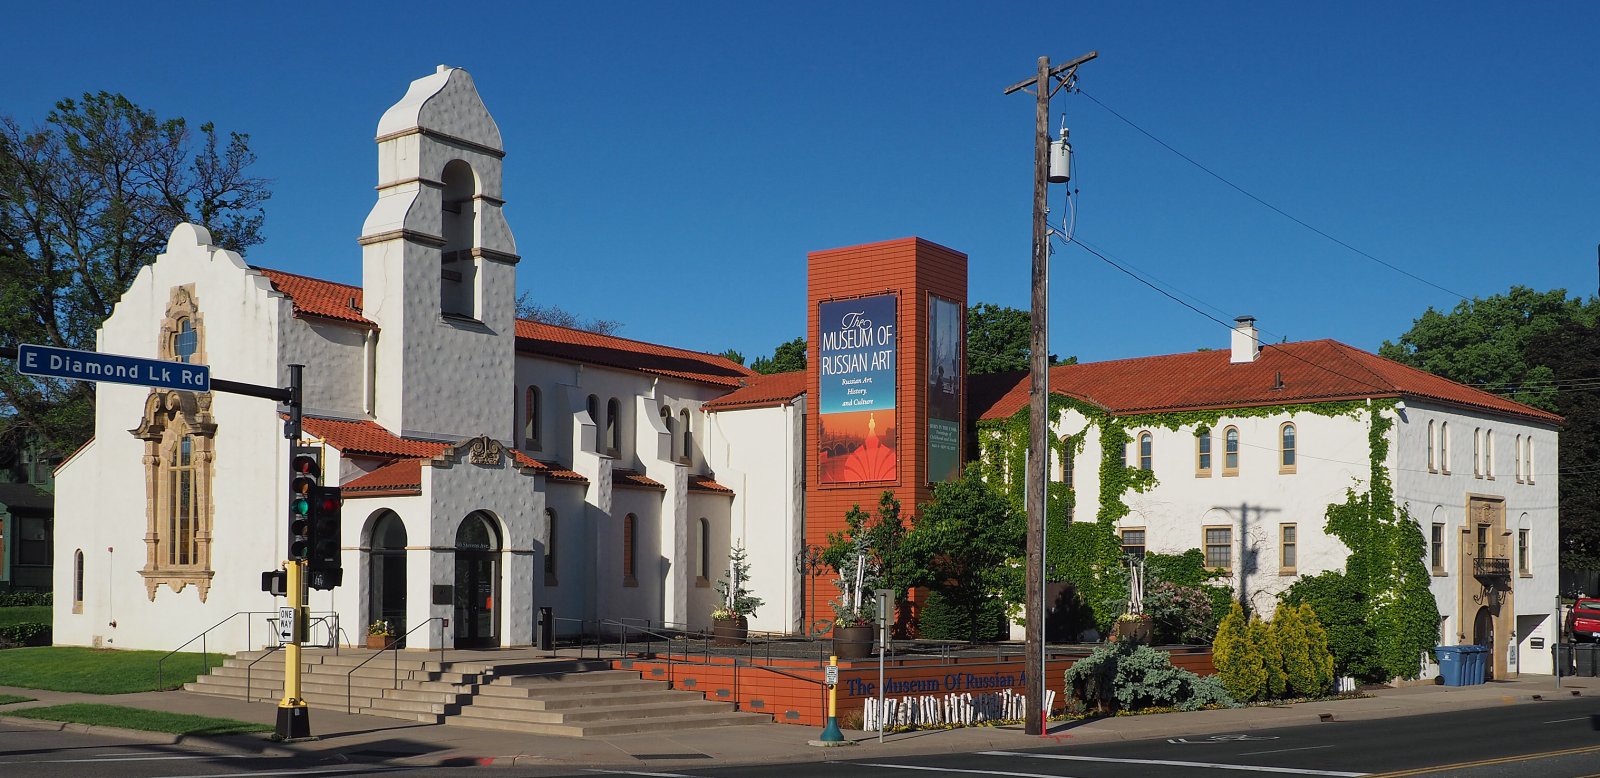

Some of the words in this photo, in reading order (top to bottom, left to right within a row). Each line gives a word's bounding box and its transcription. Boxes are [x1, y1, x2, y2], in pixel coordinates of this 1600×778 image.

[842, 310, 872, 330] The
[822, 327, 873, 351] MUSEUM
[877, 325, 893, 346] OF
[25, 352, 38, 368] E
[50, 355, 139, 379] Diamond
[149, 366, 171, 383] Lk
[181, 370, 204, 386] Rd
[822, 353, 868, 376] RUSSIAN
[871, 350, 892, 371] ART
[842, 377, 862, 386] Russian
[842, 399, 853, 407] and
[853, 398, 874, 406] Culture
[281, 610, 292, 618] ONE
[281, 620, 292, 628] WAY
[846, 677, 876, 697] The
[882, 676, 940, 696] Museum
[943, 672, 963, 692] Of
[965, 671, 1015, 690] Russian
